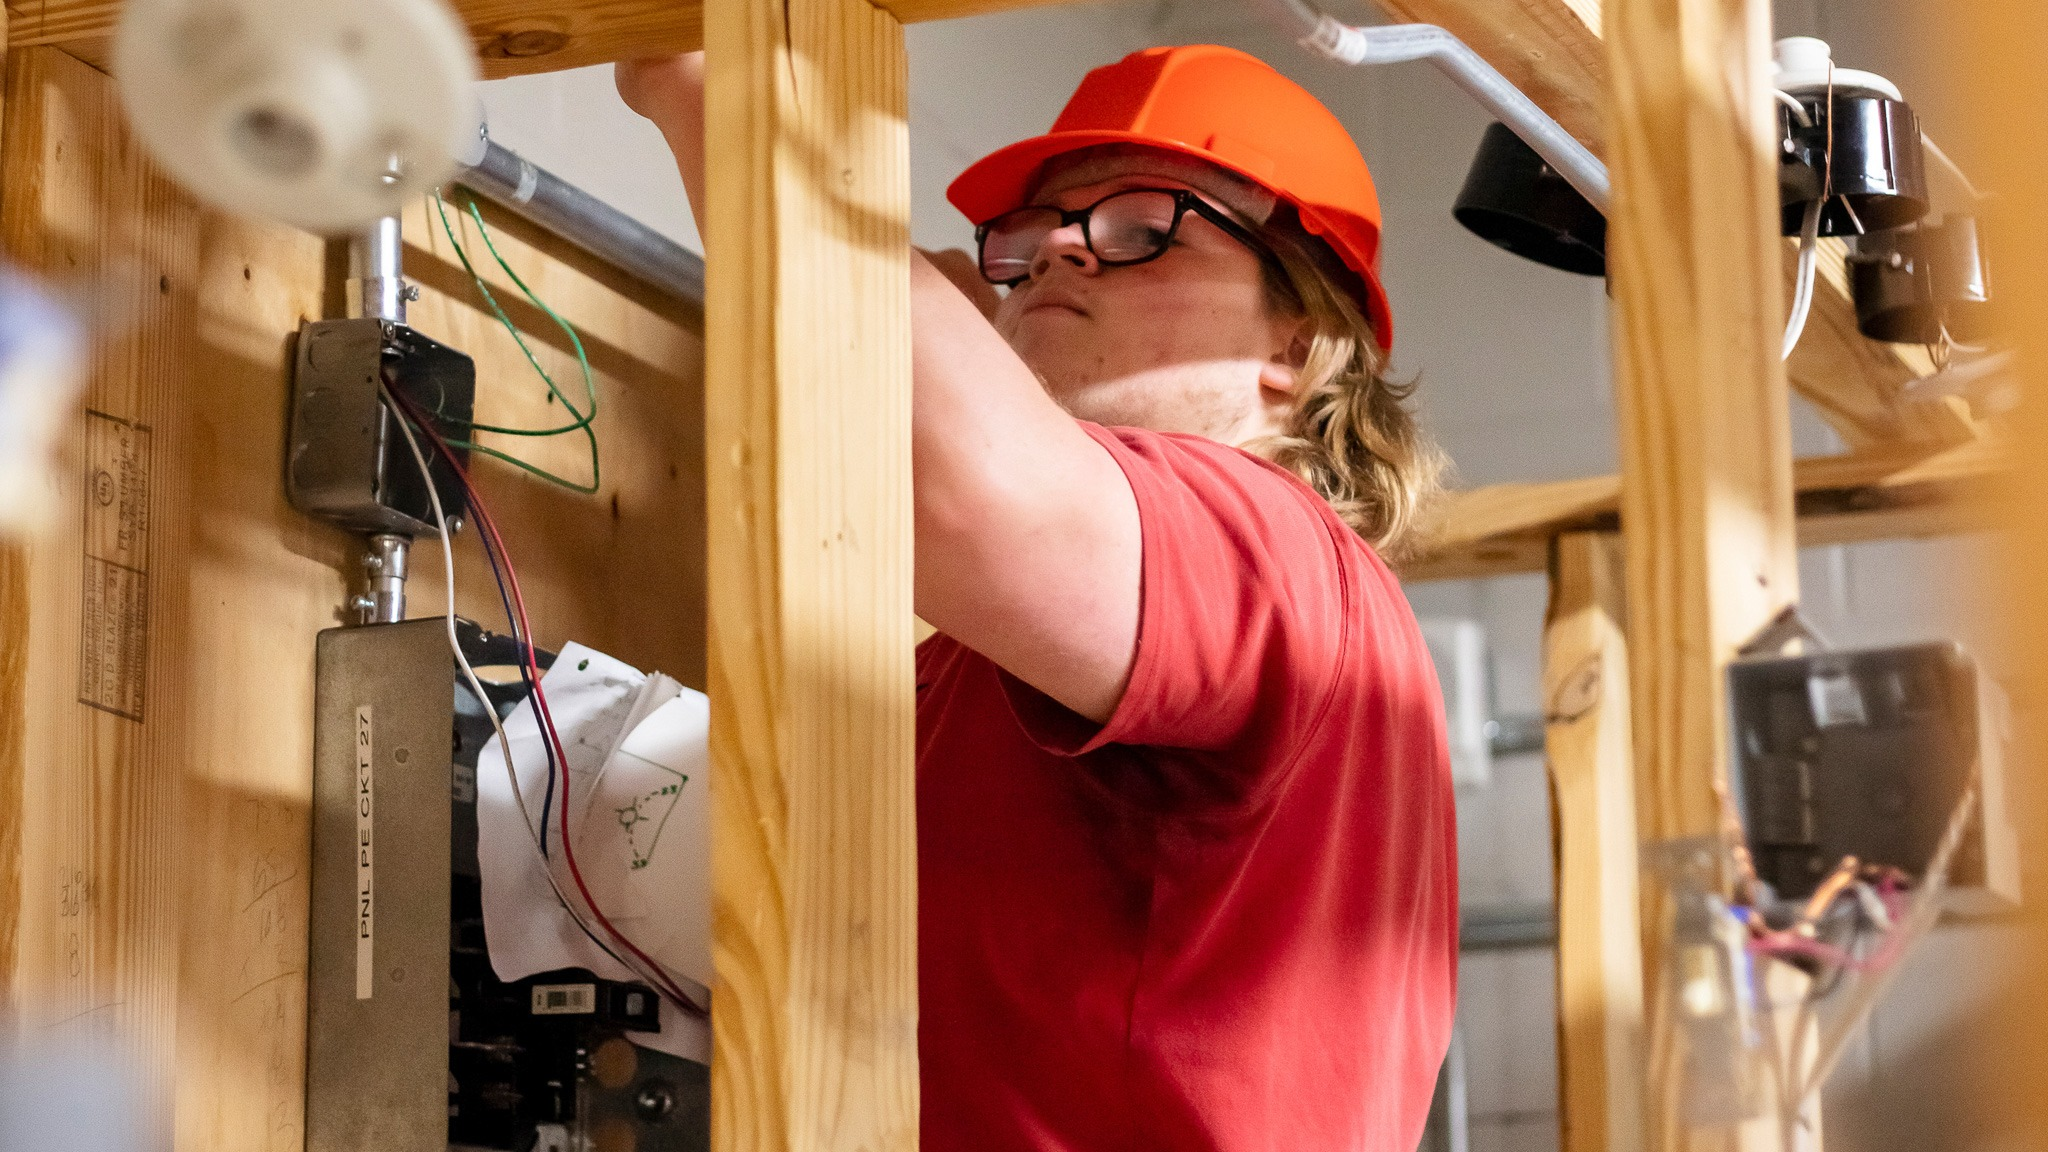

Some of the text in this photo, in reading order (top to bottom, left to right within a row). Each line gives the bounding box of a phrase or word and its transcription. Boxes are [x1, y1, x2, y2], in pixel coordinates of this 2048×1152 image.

[360, 712, 370, 938] PNL PE CKT 27
